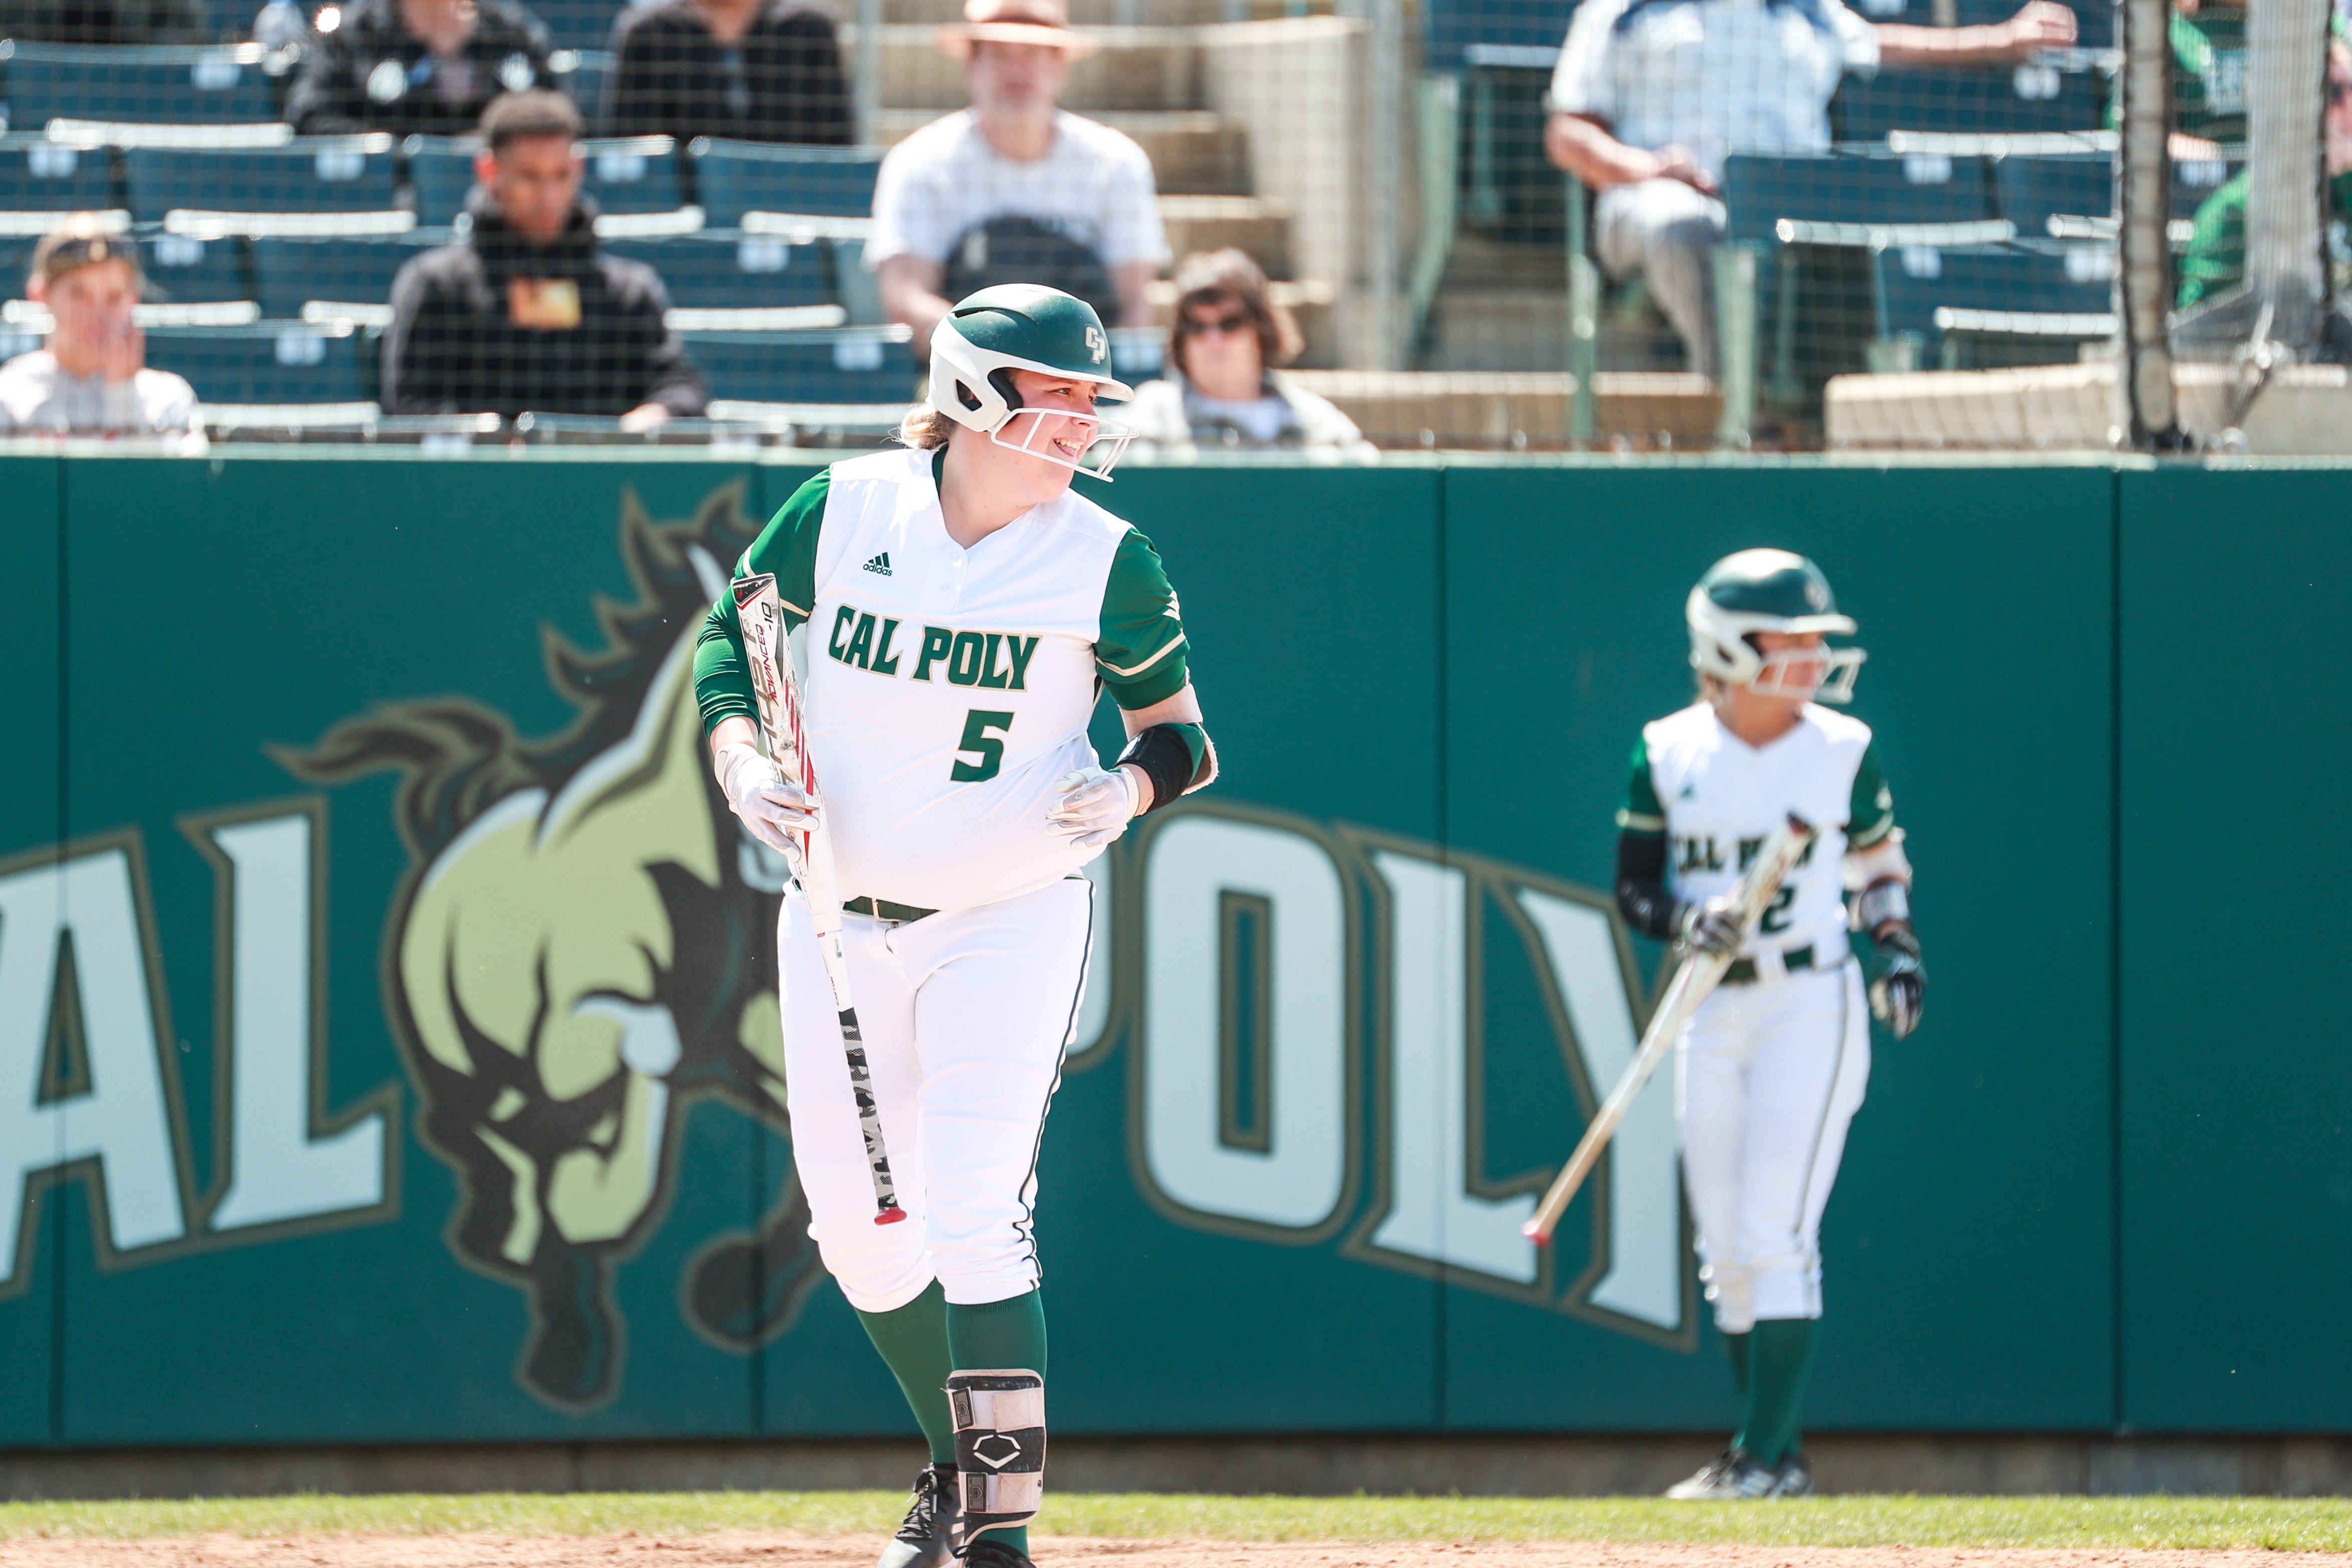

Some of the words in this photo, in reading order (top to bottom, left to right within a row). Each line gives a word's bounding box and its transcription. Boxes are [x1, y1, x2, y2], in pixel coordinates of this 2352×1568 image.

[863, 563, 893, 577] adidas
[761, 601, 774, 631] -10
[828, 603, 903, 679] CAL
[909, 624, 1043, 693] POLY
[755, 623, 779, 708] ADVANCED
[950, 708, 1016, 782] 5
[1759, 884, 1795, 935] 2
[1062, 802, 1696, 1353] OLY
